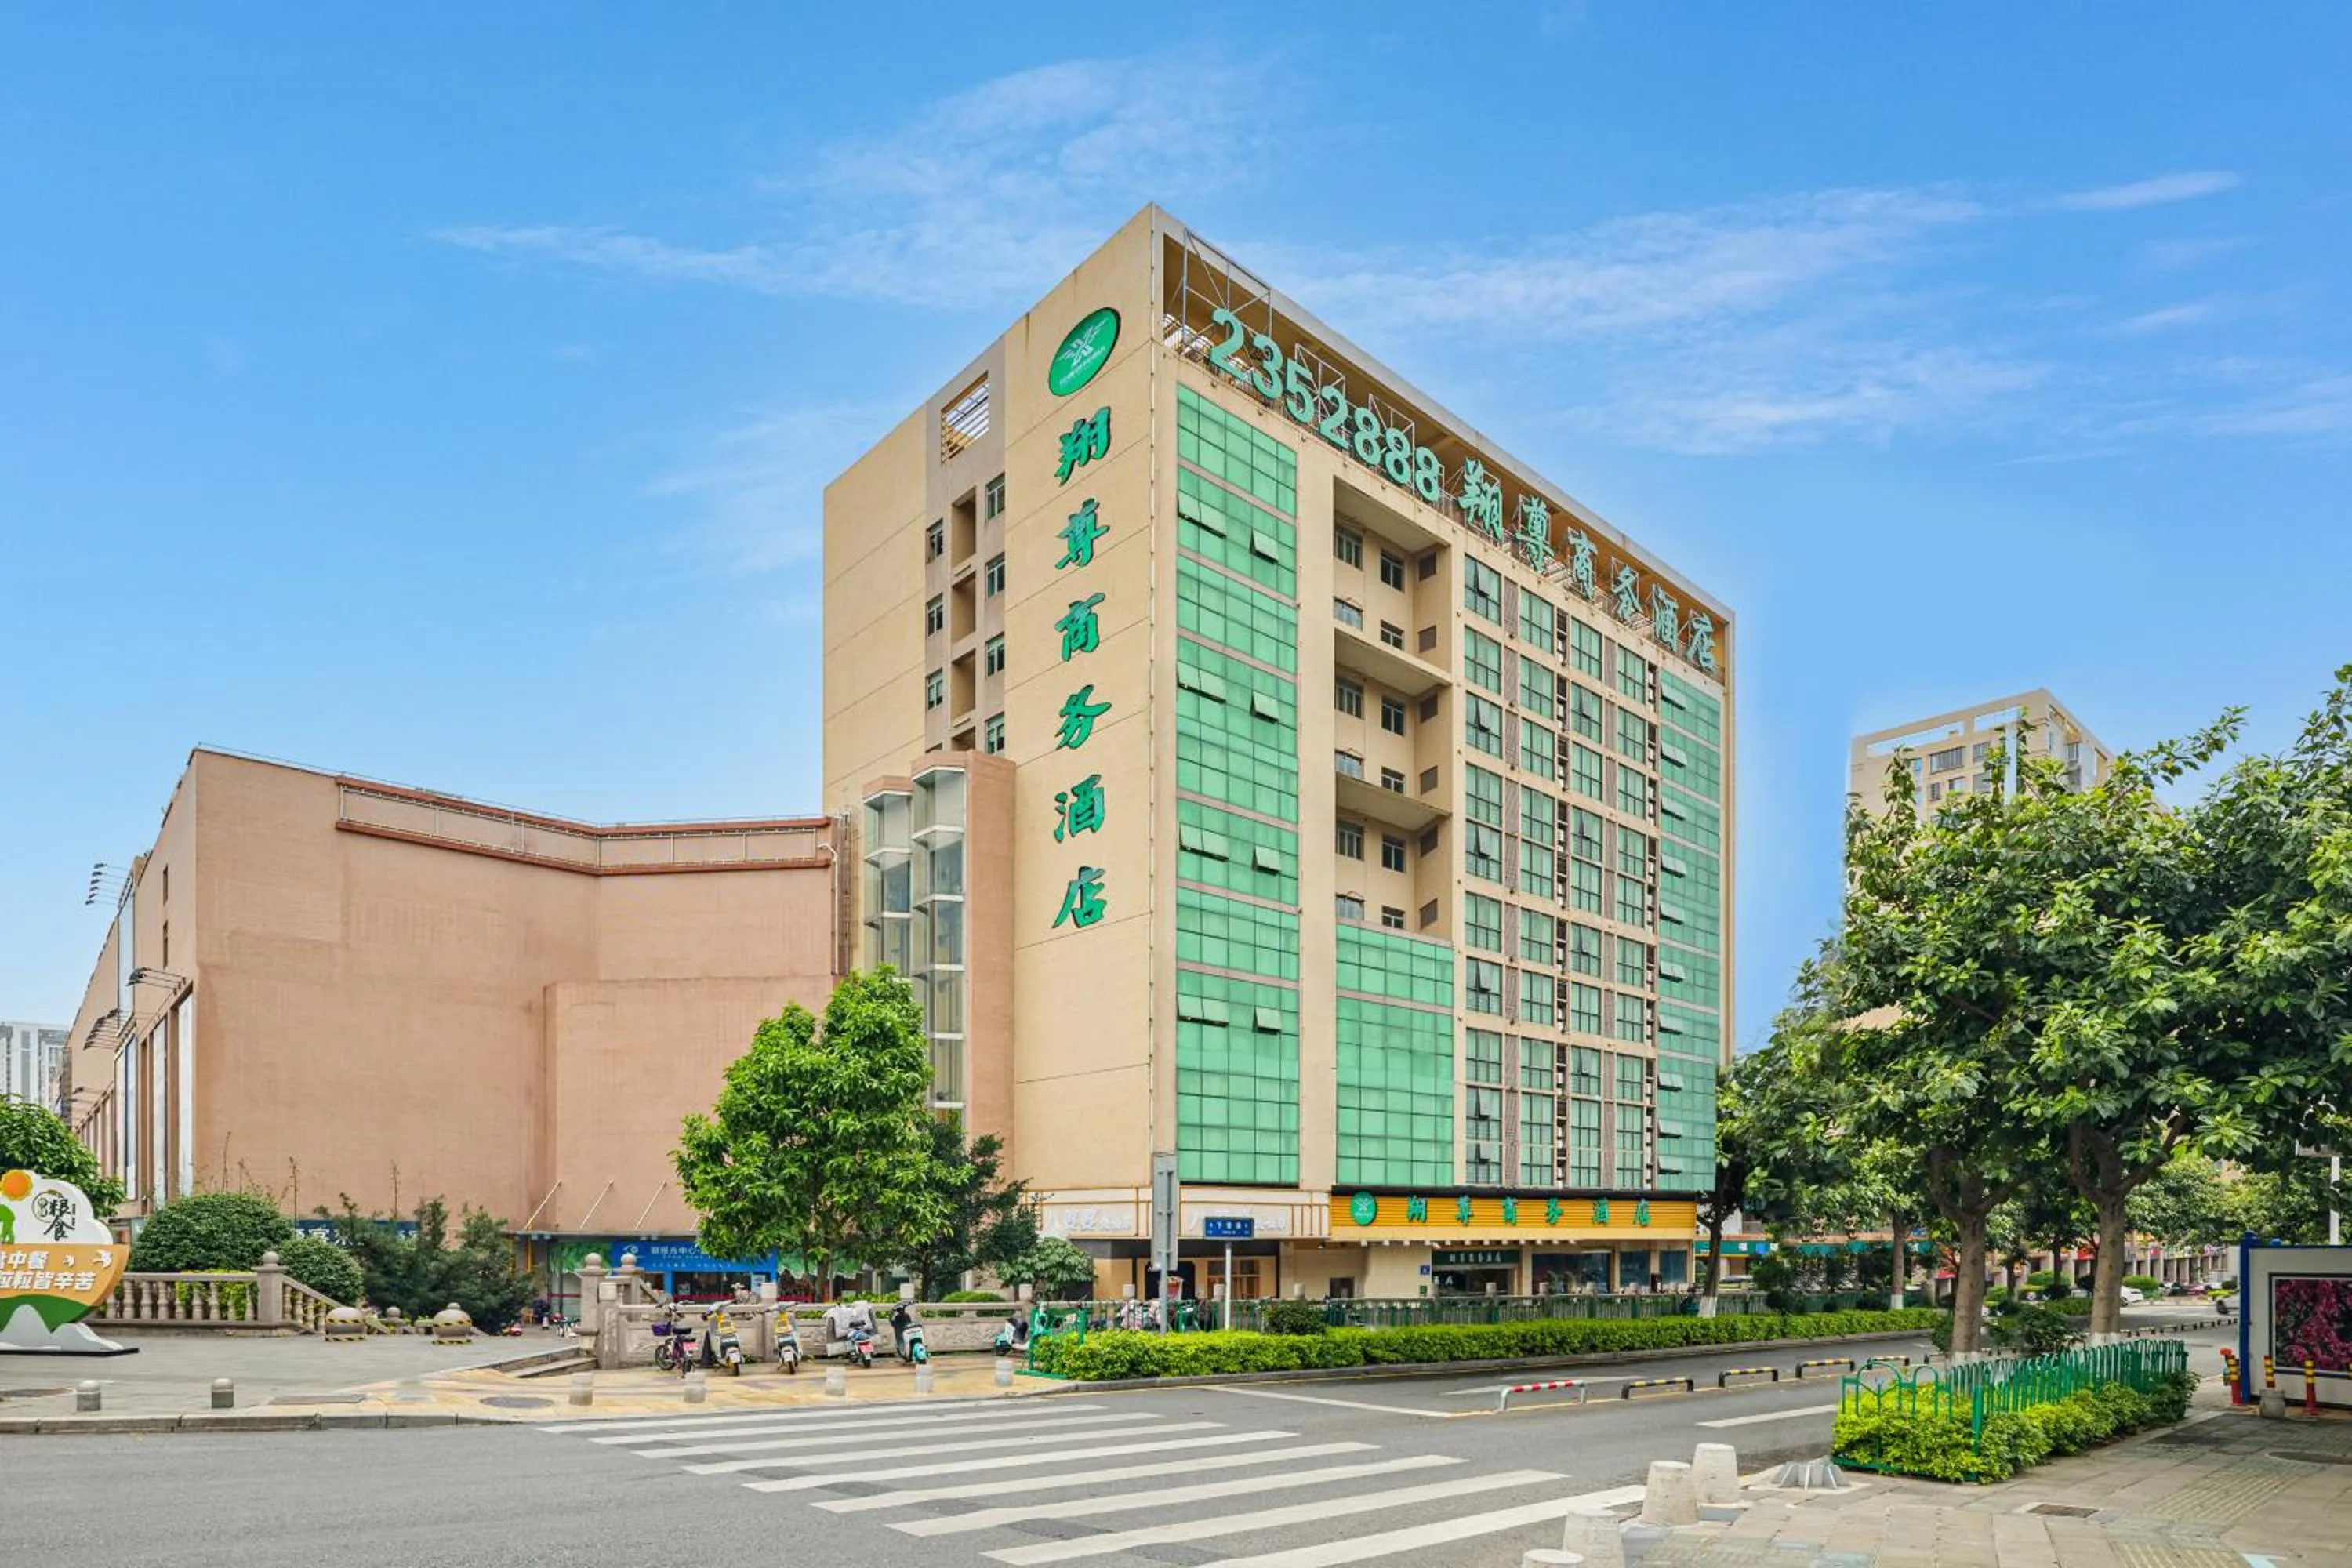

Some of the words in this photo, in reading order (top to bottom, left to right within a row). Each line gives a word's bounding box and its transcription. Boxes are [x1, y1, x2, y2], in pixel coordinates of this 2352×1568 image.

[1210, 307, 1443, 503] 2352888
[1053, 405, 1112, 928] 翔尊商务酒店
[1406, 1195, 1652, 1227] 翔尊商务酒店
